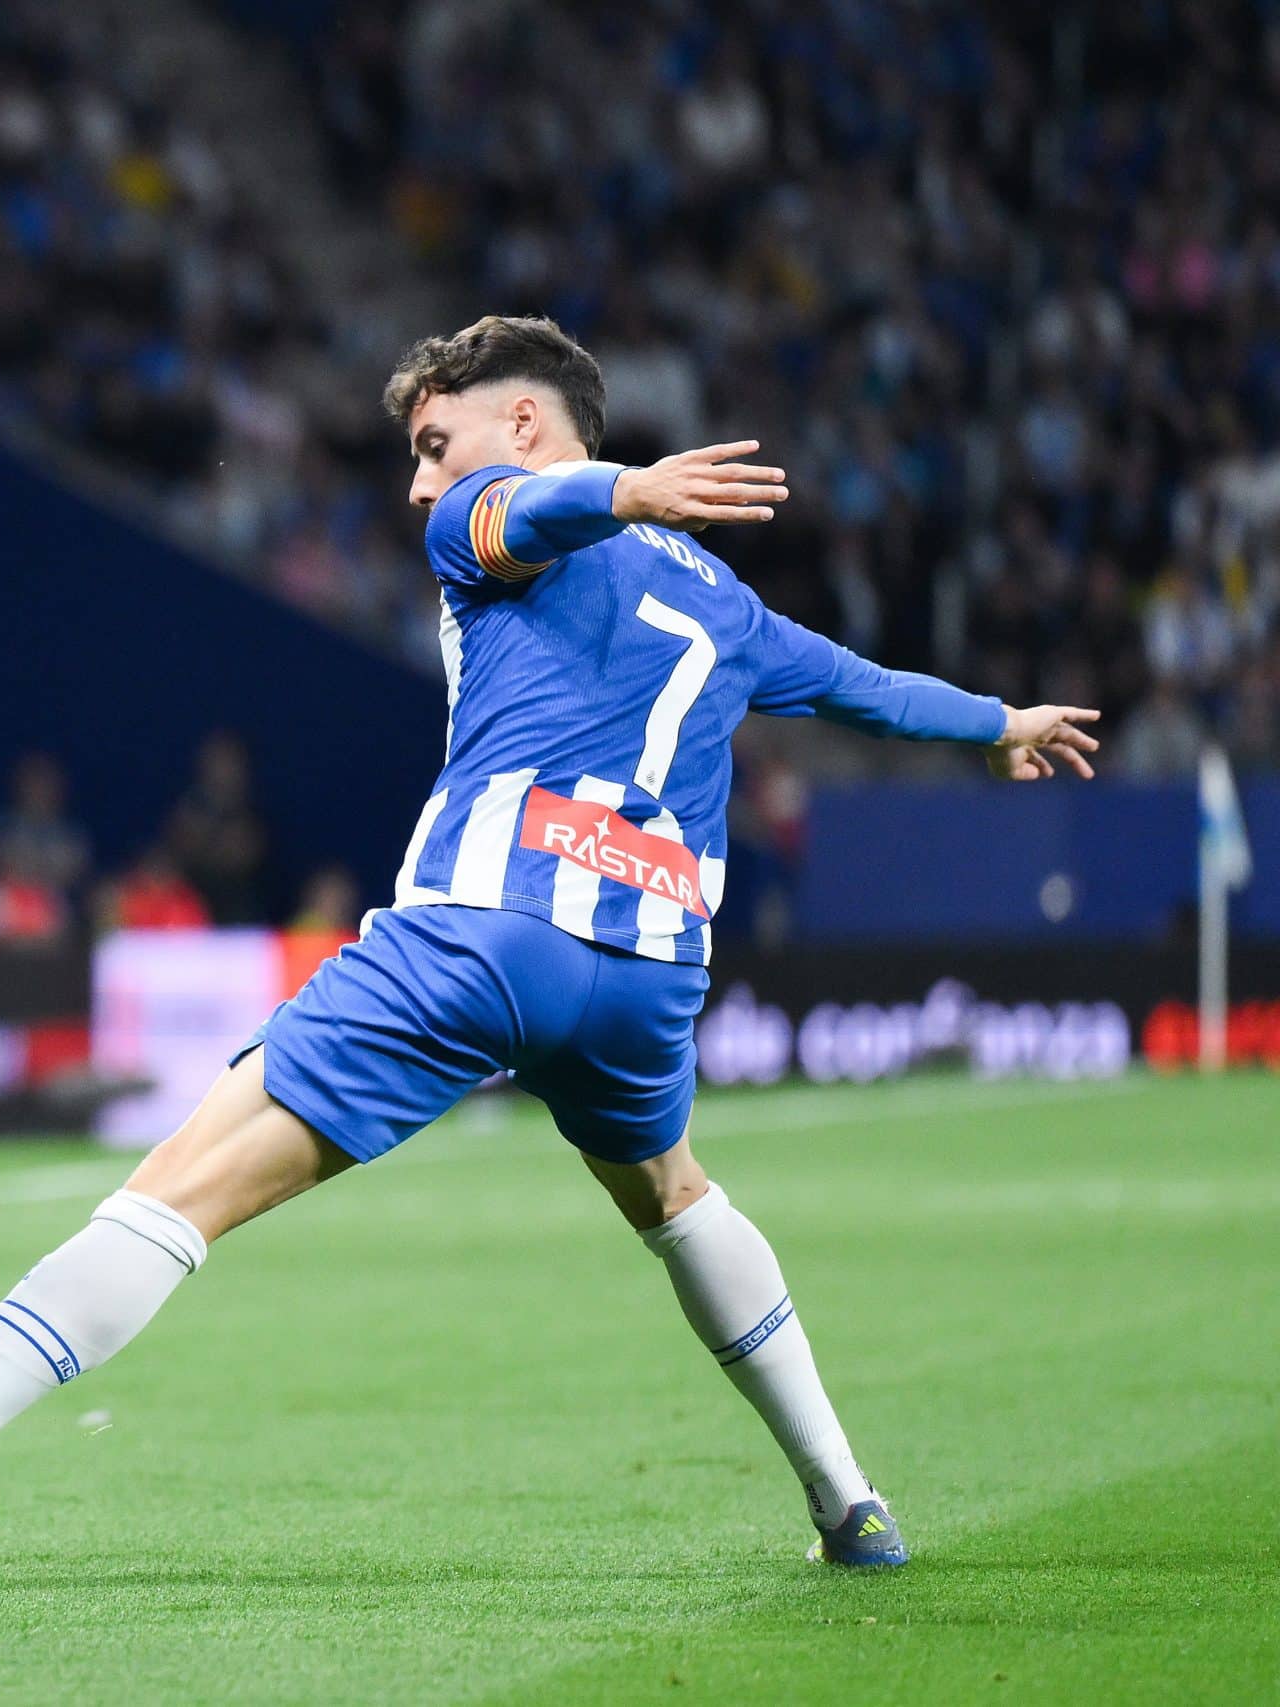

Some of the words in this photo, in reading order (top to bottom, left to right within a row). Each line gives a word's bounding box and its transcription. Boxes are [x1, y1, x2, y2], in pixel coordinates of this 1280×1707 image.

[634, 592, 717, 801] 7
[543, 822, 696, 911] RASTAR
[737, 1311, 784, 1353] RCDE
